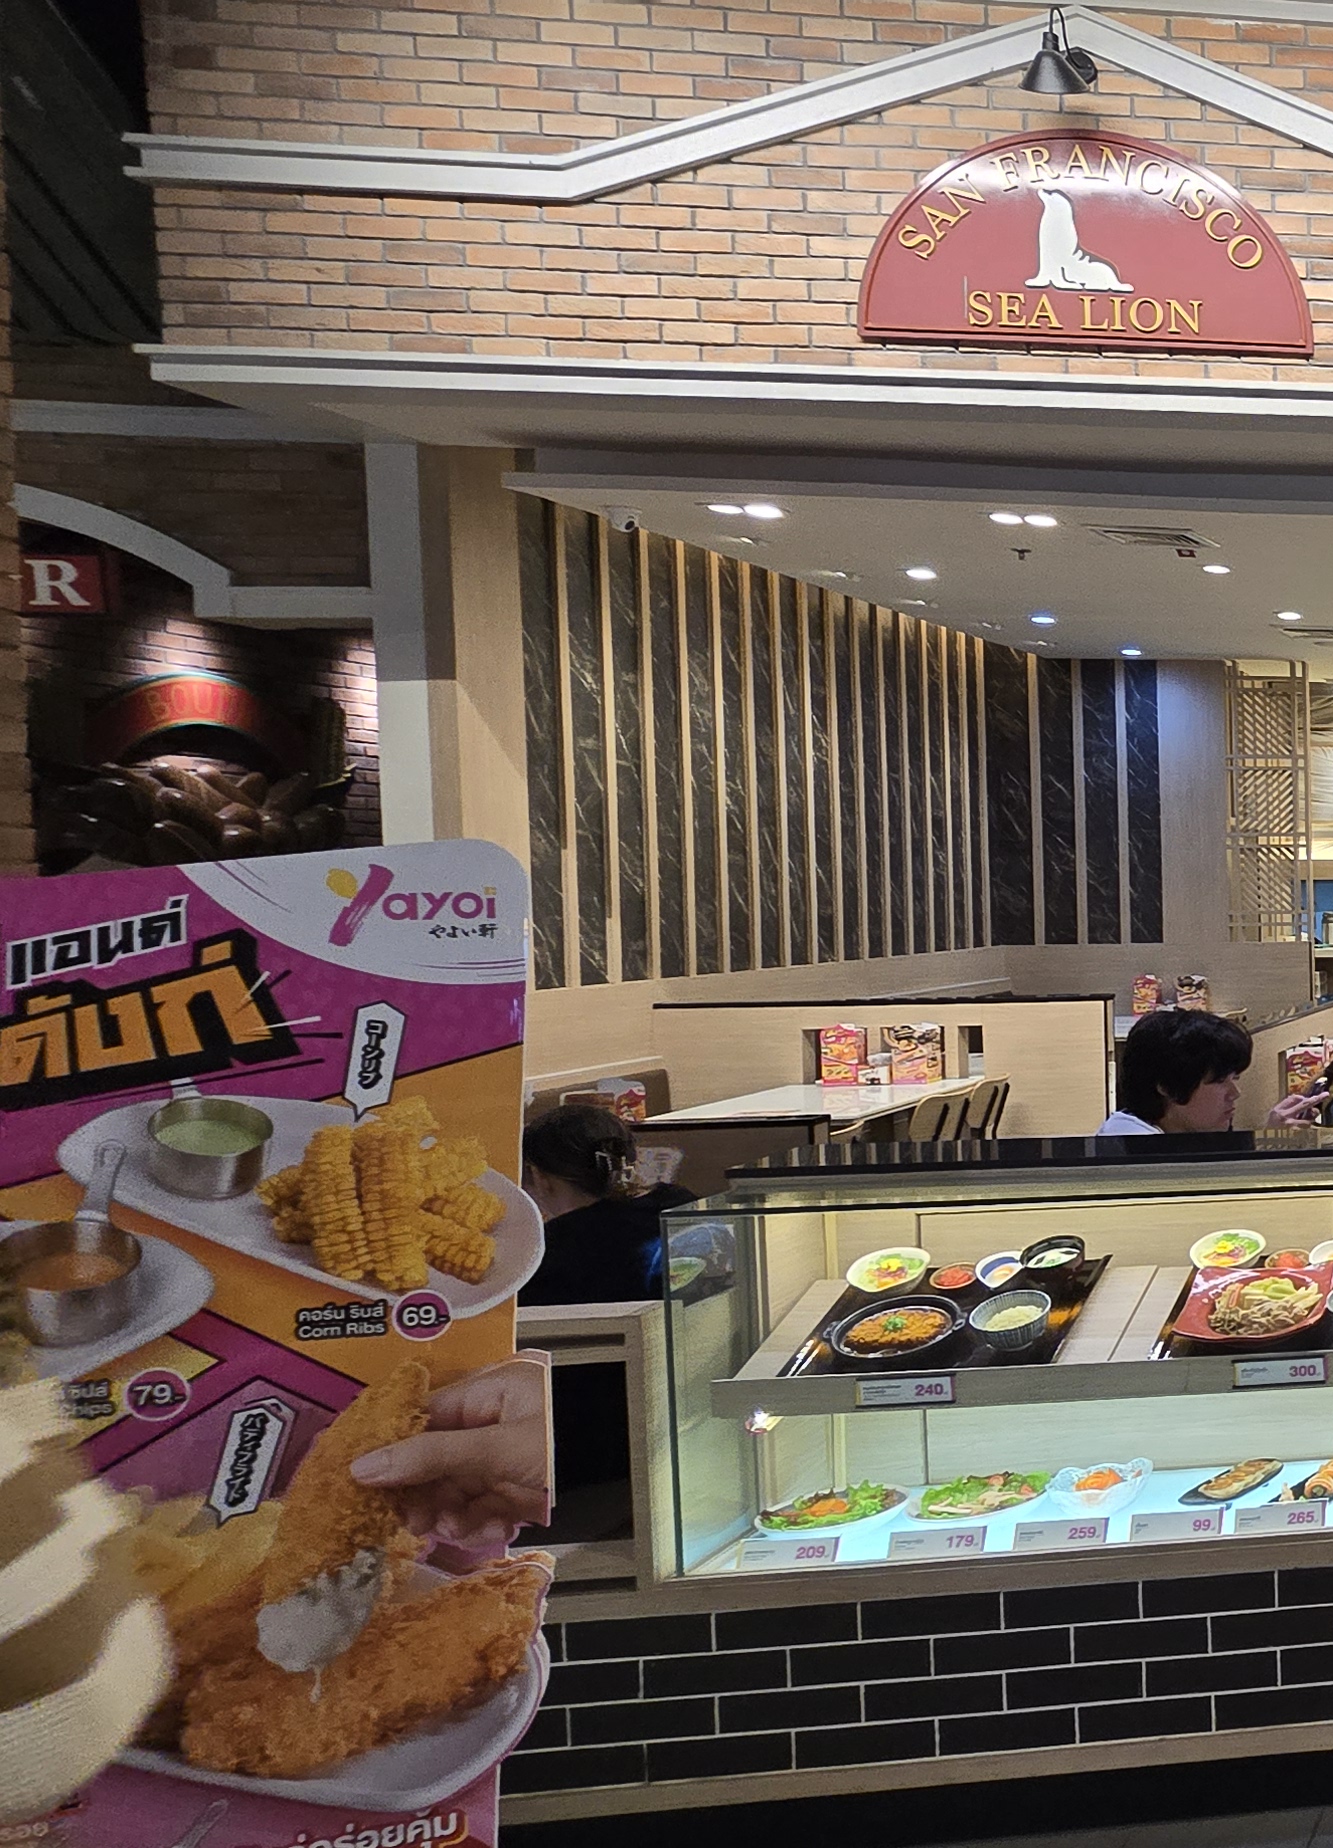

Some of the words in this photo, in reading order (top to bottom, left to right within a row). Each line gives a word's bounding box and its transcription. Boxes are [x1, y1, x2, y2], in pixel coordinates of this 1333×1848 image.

[898, 172, 986, 260] SAN
[989, 143, 1264, 270] FRANCISCO
[967, 290, 1062, 330] SEA
[1078, 294, 1203, 335] LION
[325, 863, 498, 947] Yayoi
[298, 1325, 342, 1339] Corn
[345, 1322, 386, 1336] Ribs
